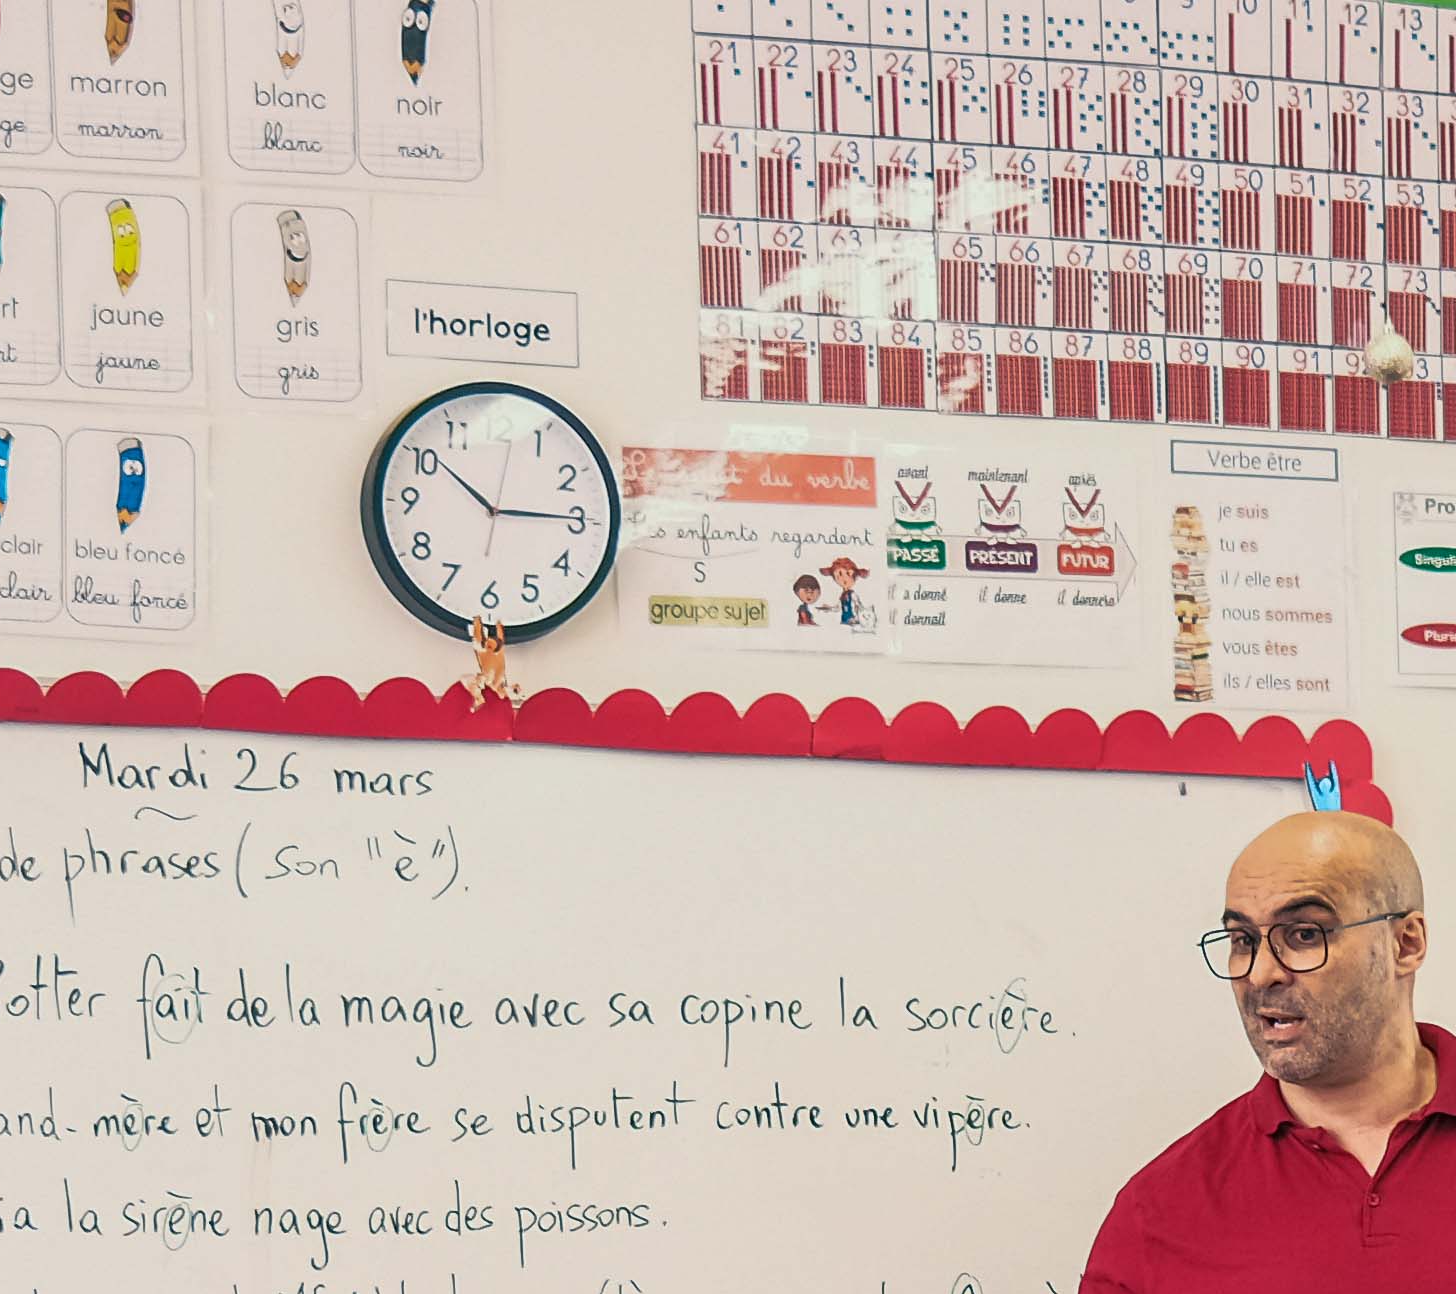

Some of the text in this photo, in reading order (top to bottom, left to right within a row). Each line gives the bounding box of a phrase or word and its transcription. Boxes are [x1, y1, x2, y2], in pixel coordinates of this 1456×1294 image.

[71, 76, 166, 96] marron
[254, 84, 325, 109] blanc
[397, 96, 442, 115] noir
[90, 304, 164, 330] jaune
[276, 317, 319, 342] gris
[415, 308, 550, 346] l'horloge
[1207, 449, 1302, 471] Verbe être
[759, 465, 791, 488] du
[807, 469, 870, 491] verbe
[0, 535, 42, 555] clair
[677, 514, 873, 559] enfants regardent
[75, 539, 185, 565] bleu foncé
[893, 543, 1108, 569] PASSÉ PRÉSENT FUTUR
[651, 601, 766, 624] groupe sujet
[1222, 608, 1332, 623] nous sommes
[1223, 640, 1297, 656] vous êtes
[79, 743, 432, 795] Mardi 26 mars
[63, 826, 222, 927] phrases
[137, 953, 207, 1060] fait
[228, 968, 274, 1027] de
[287, 964, 320, 1026] la
[343, 989, 472, 1067] magie
[495, 994, 584, 1027] avec
[609, 993, 653, 1026] sa
[681, 995, 812, 1067] copine
[840, 977, 877, 1029] la
[907, 990, 1075, 1036] sorcière.
[196, 1085, 231, 1137] et
[251, 1113, 316, 1141] mon
[338, 1082, 430, 1163] frère
[452, 1108, 492, 1142] se
[517, 1081, 695, 1170] disputent
[717, 1082, 822, 1129] contre
[845, 1108, 897, 1128] une
[913, 1095, 1030, 1172] vipère.
[65, 1178, 102, 1235] la
[123, 1191, 229, 1237] sirène
[254, 1208, 345, 1270] nage
[369, 1208, 432, 1235] avec
[445, 1180, 493, 1235] des
[515, 1202, 667, 1268] poissons.
